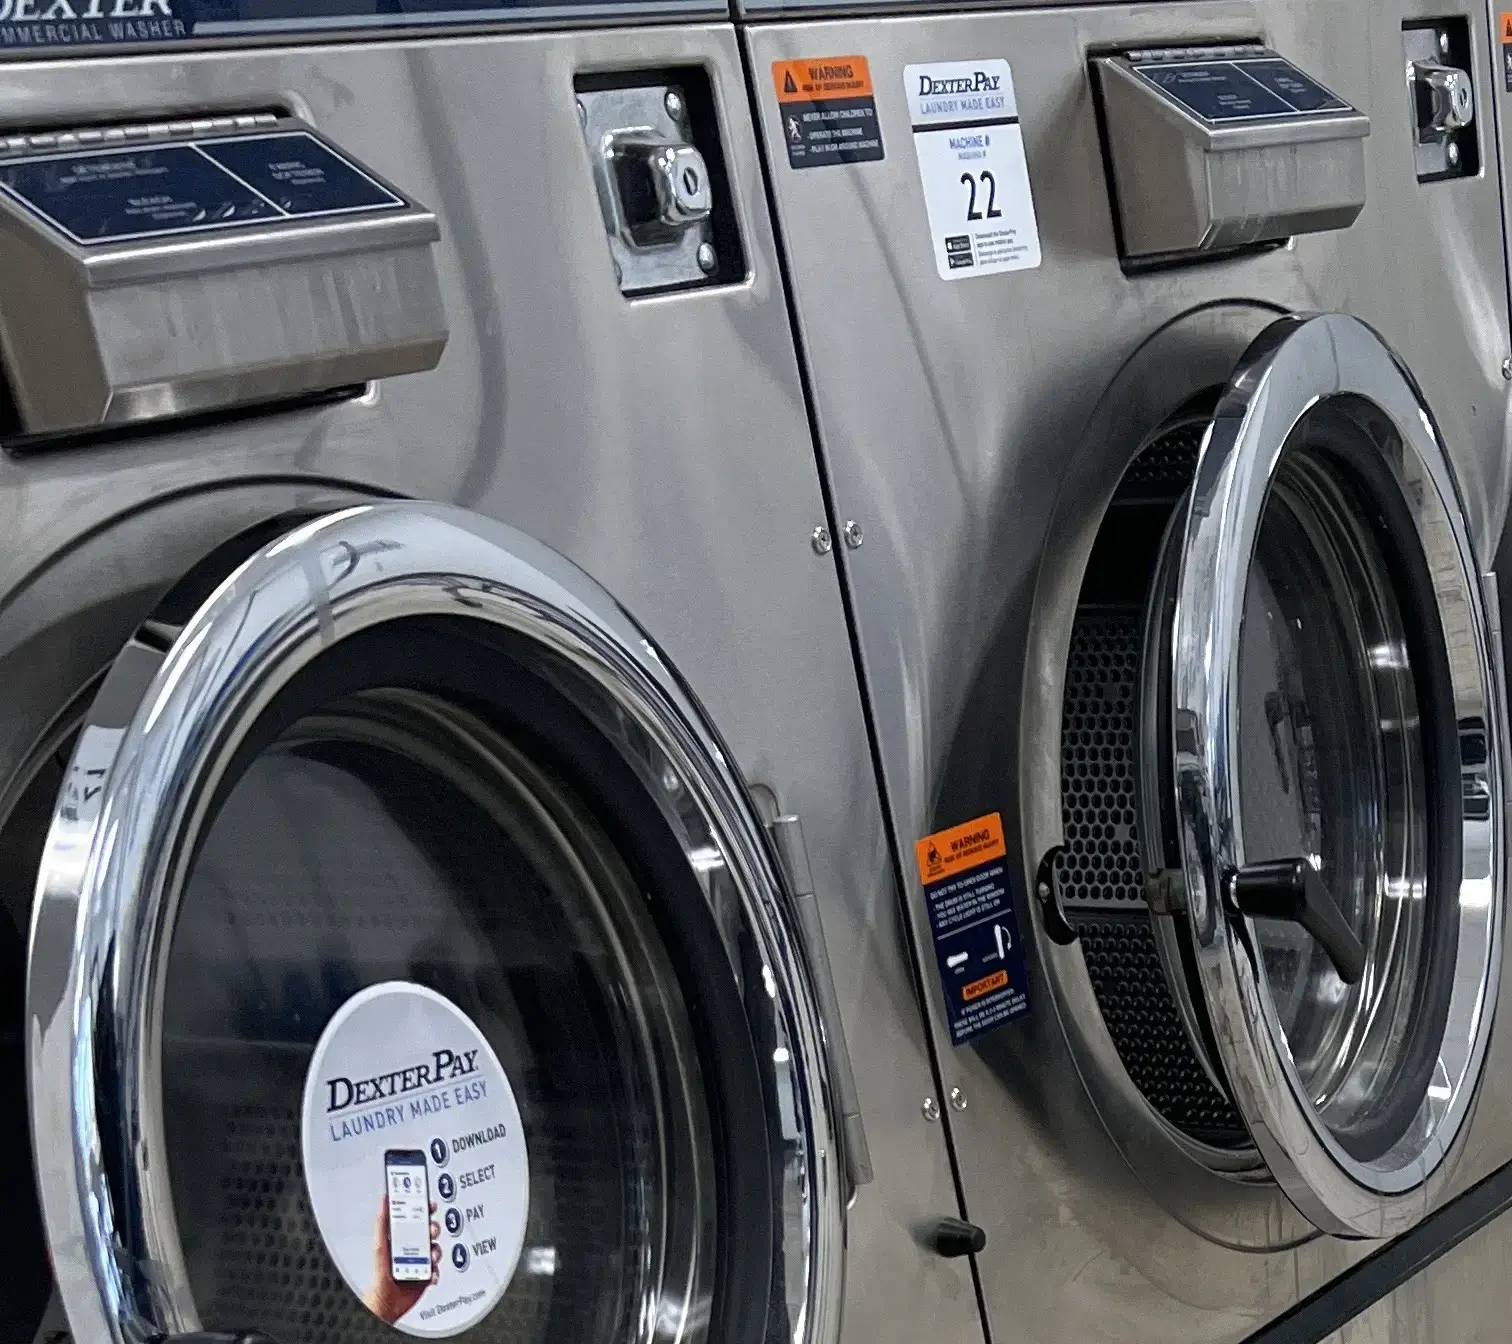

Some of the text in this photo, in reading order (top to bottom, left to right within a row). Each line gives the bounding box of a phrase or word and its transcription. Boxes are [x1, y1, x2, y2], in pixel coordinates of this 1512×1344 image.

[0, 0, 173, 20] EXTER
[108, 18, 187, 40] WASHER
[807, 65, 854, 80] WARNING
[920, 96, 1005, 115] LAUNDRY MADE EASY
[949, 135, 984, 149] MACHINE
[960, 170, 1002, 221] 22
[330, 1079, 488, 1142] LAUNDRY MADE EASY
[452, 1123, 506, 1153] DOWNLOAD
[459, 1164, 496, 1189] SELECT
[466, 1203, 485, 1223] PAY
[472, 1236, 497, 1257] VIEW
